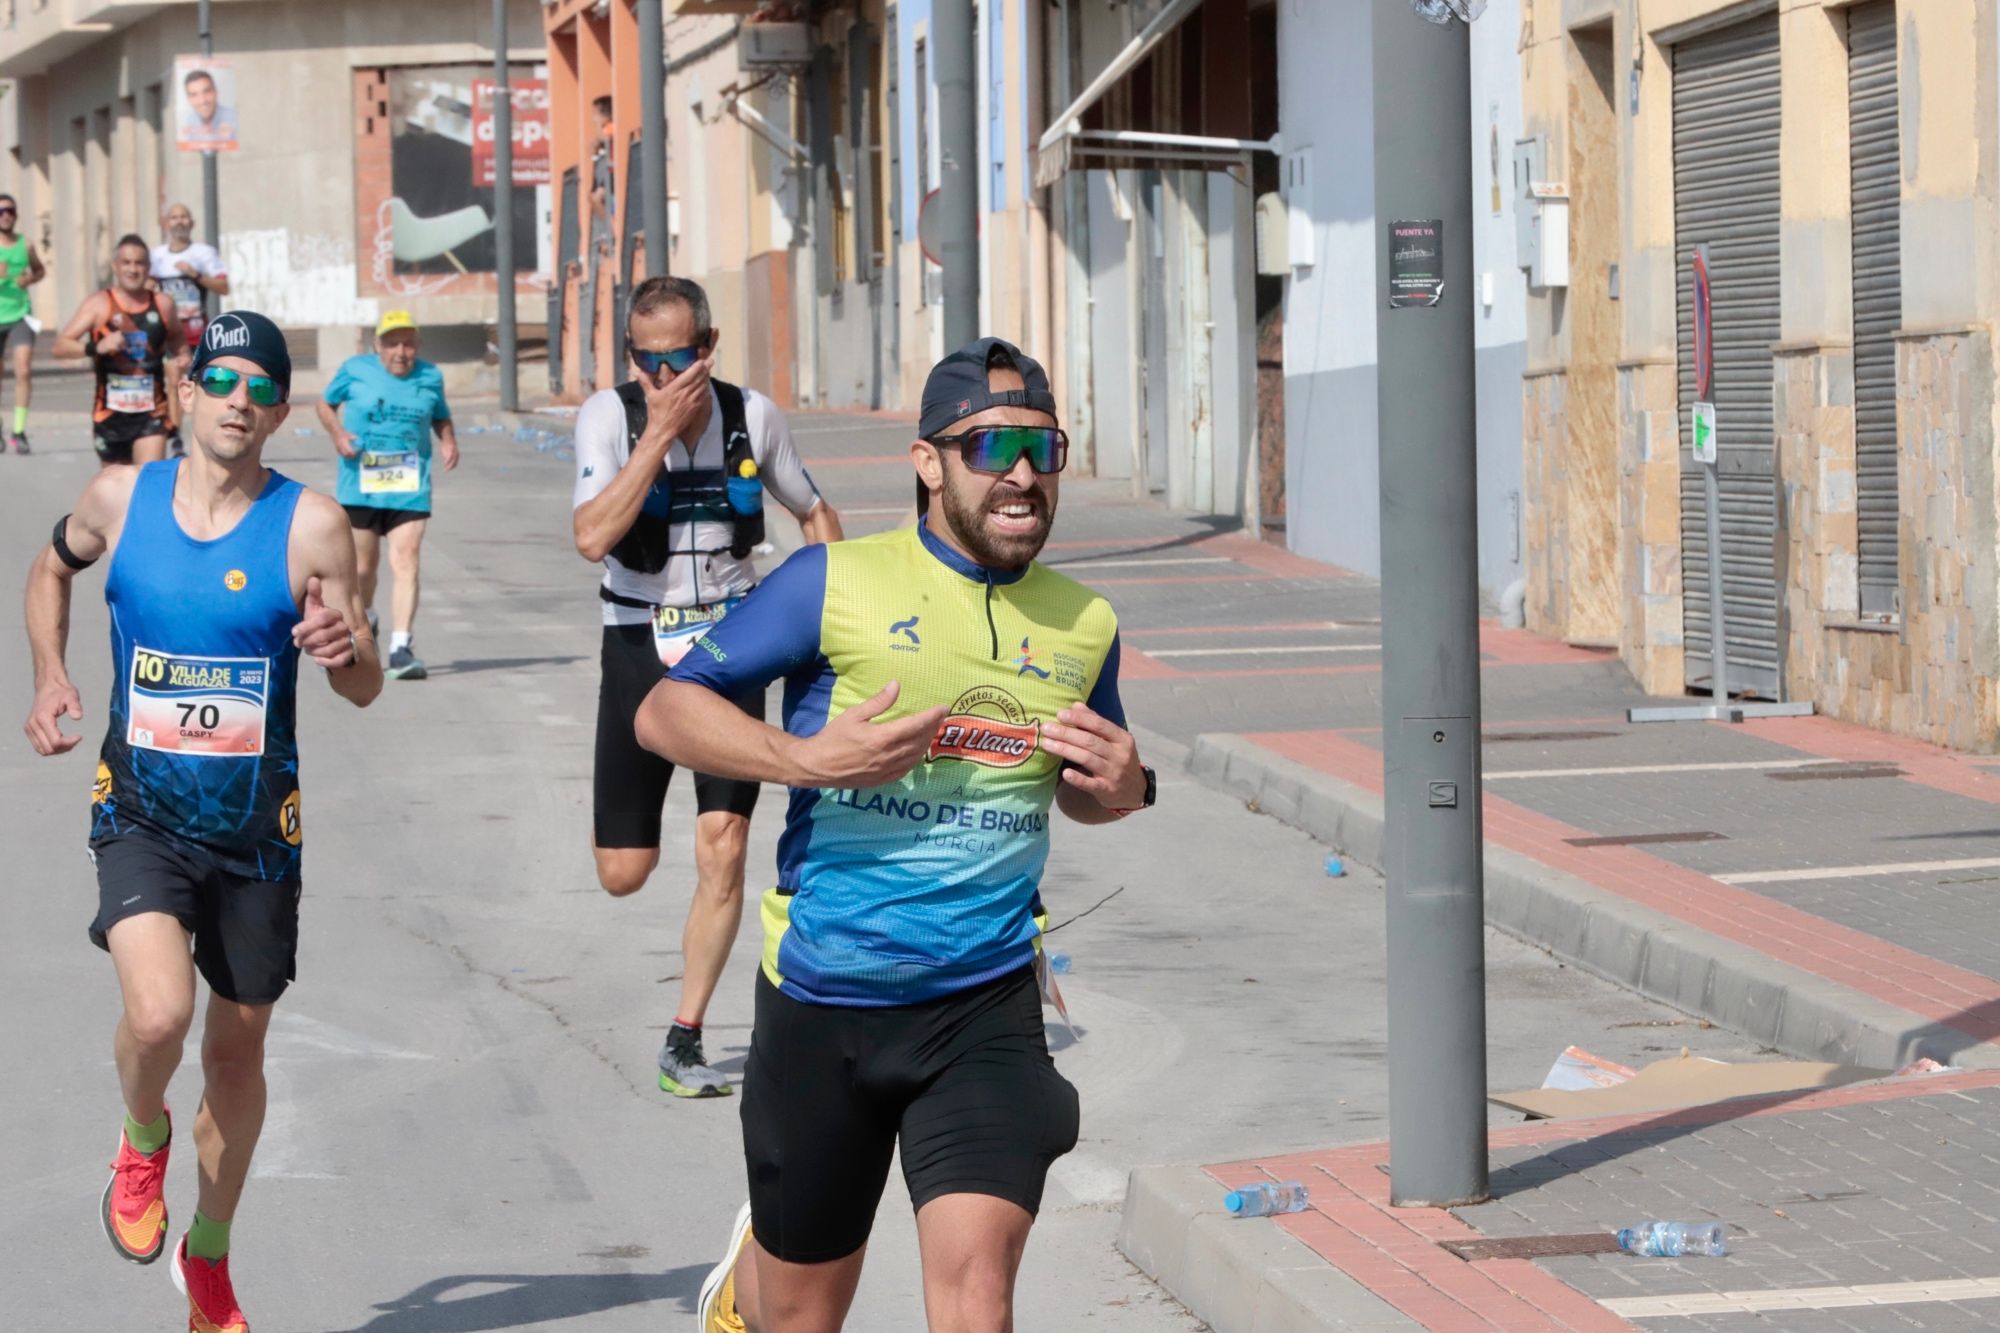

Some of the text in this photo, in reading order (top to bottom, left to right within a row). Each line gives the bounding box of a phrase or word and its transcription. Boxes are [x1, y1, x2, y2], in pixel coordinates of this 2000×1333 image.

[1395, 228, 1422, 236] PUENTE
[378, 470, 404, 481] 324
[169, 665, 231, 680] VILLA DE
[169, 676, 231, 688] ALGUAZAS
[239, 676, 262, 685] 2023
[961, 691, 1019, 718] frutos secos
[176, 703, 220, 729] 70
[180, 729, 214, 738] GASPY
[940, 726, 1028, 756] El Llano
[837, 788, 930, 822] LLANO
[936, 804, 975, 828] DE
[914, 832, 996, 854] MURCIA
